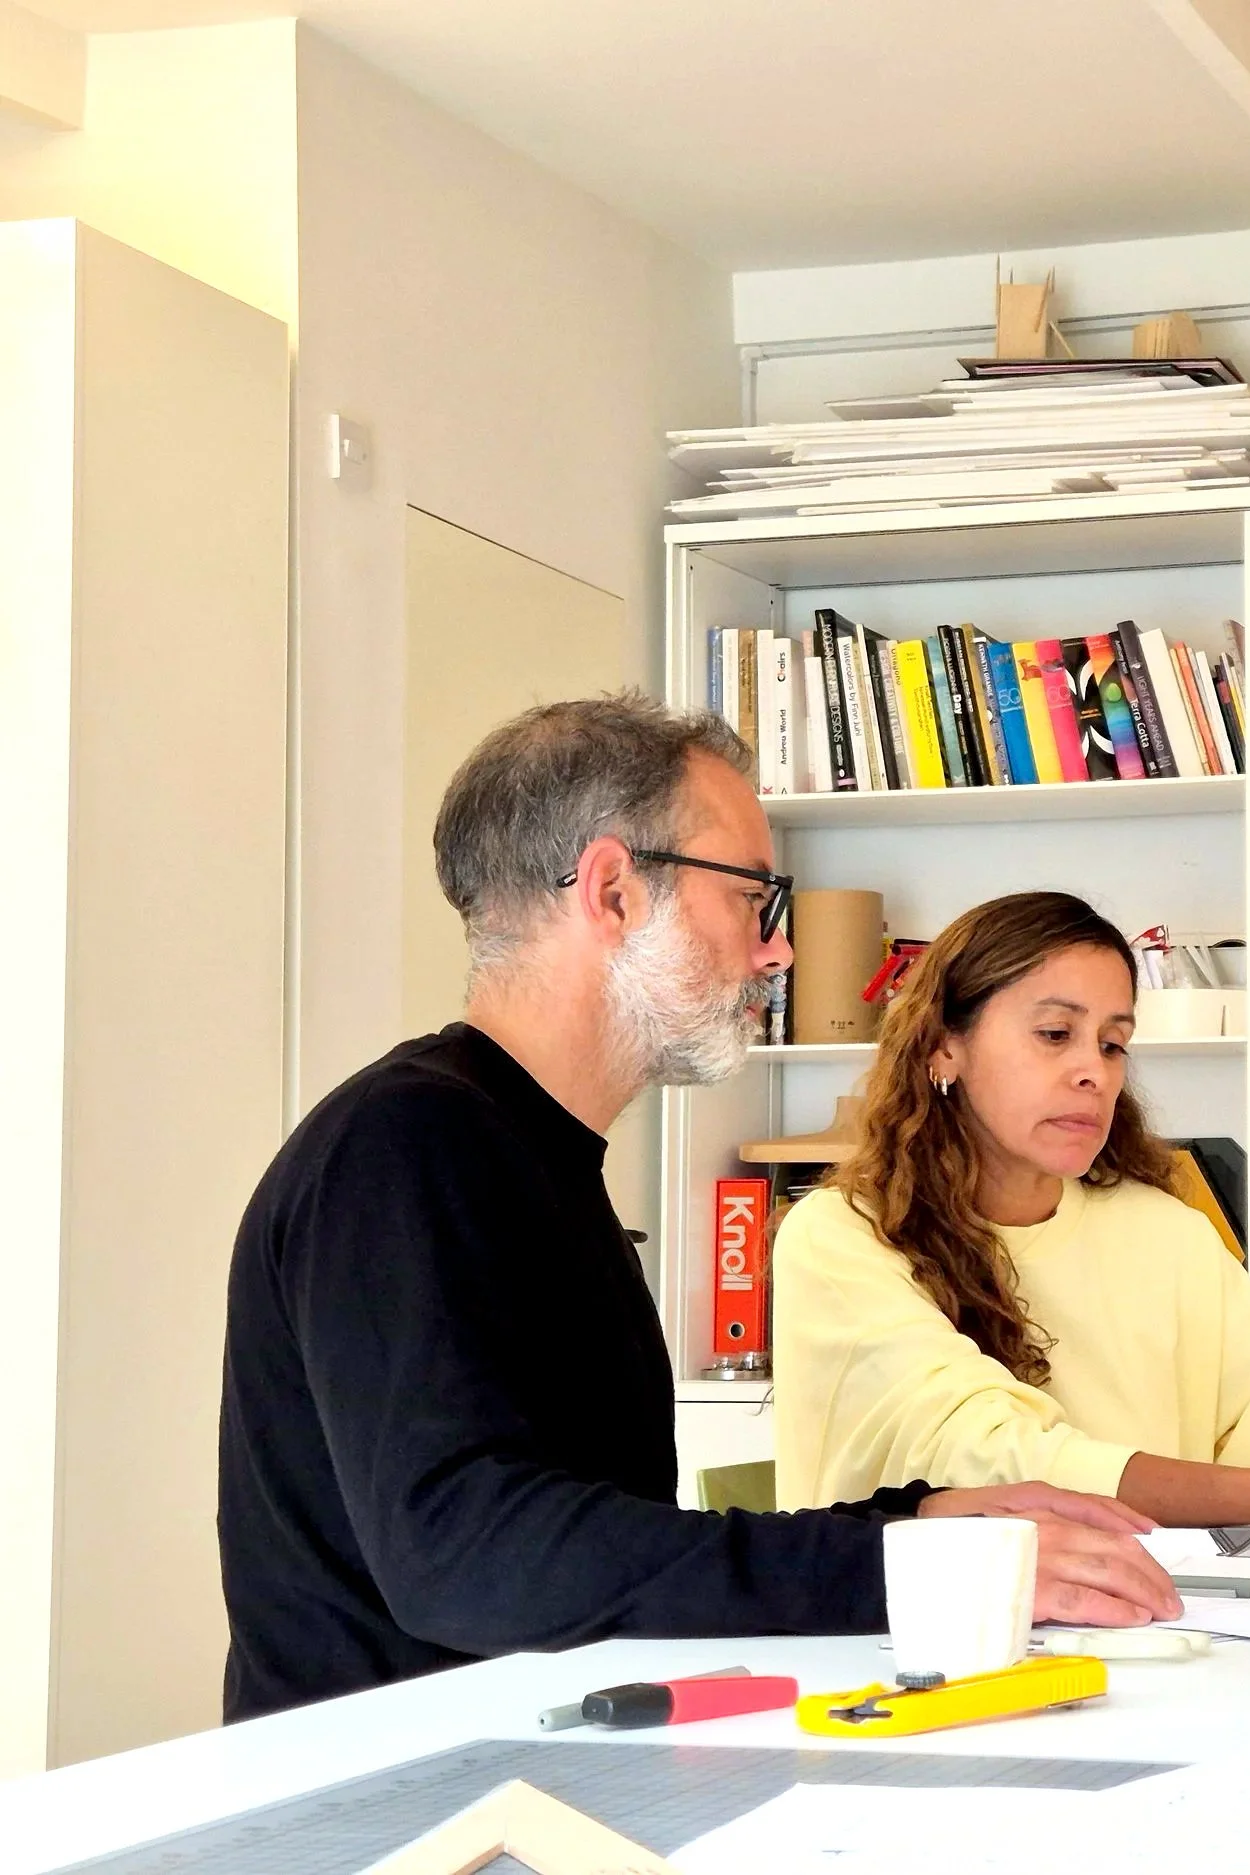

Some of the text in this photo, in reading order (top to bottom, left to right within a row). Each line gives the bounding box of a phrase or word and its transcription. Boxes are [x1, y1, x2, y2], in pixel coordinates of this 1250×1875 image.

[777, 652, 786, 682] Chairs
[822, 623, 835, 661] MODERN
[831, 705, 843, 742] DESIGNS
[843, 642, 862, 737] Watercolors by Finn Juhl
[978, 643, 994, 697] KENNETH GRANGE
[952, 693, 963, 714] Day
[1129, 698, 1150, 748] Terra Cotta
[1136, 674, 1165, 752] LIGHT YEARS AHEAD
[721, 1196, 755, 1291] Knoll
